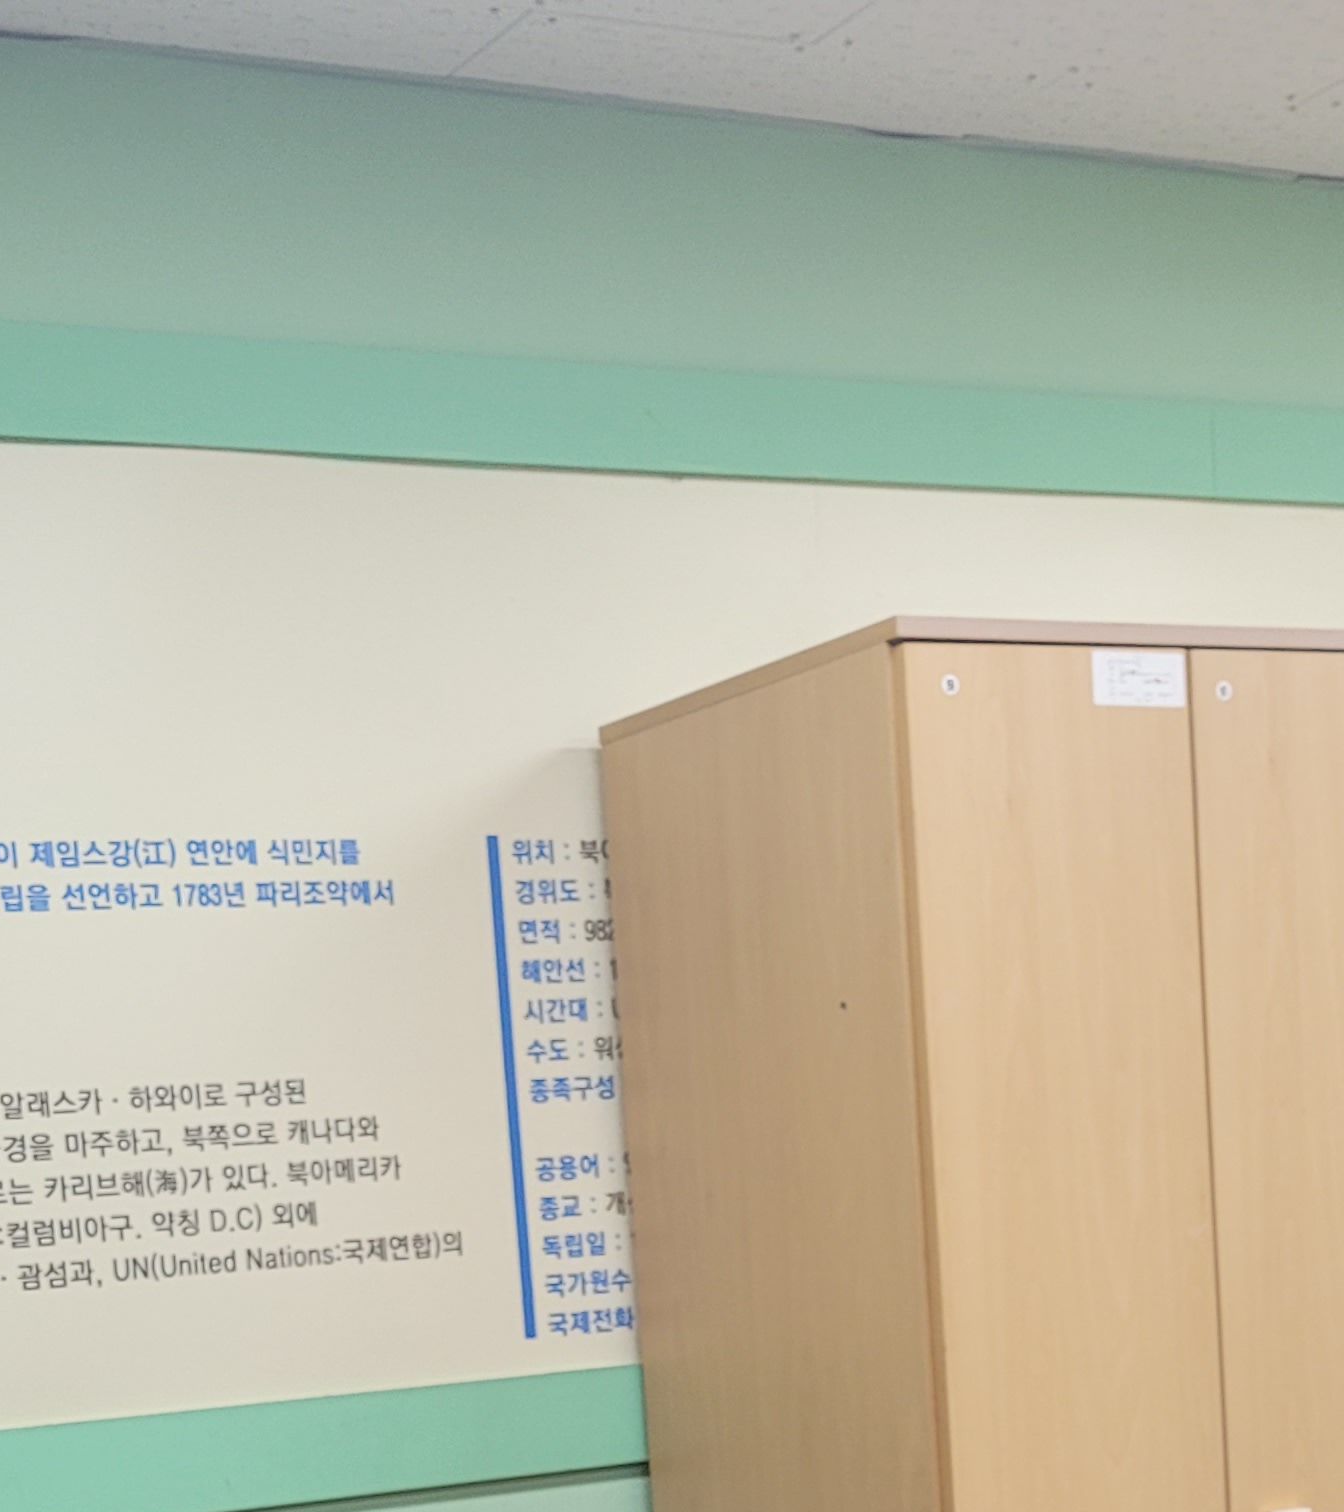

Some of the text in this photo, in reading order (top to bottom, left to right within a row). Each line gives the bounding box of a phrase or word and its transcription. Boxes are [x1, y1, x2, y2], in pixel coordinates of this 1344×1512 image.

[185, 839, 258, 867] 연안에
[266, 839, 361, 866] 식민지를
[511, 839, 555, 865] 위치
[61, 882, 164, 911] 선언하고
[172, 881, 246, 908] 1783년
[255, 879, 394, 907] 파리조약에서
[515, 879, 581, 906] 경위도
[517, 919, 561, 945] 면적
[521, 957, 586, 984] 해안선
[523, 997, 588, 1025] 시간대
[527, 1038, 570, 1064] 수도
[235, 1078, 306, 1107] 구성된
[529, 1075, 616, 1103] 종족구성
[64, 1128, 173, 1159] 마주하고,
[183, 1122, 279, 1152] 북쪽으로
[287, 1115, 380, 1145] 캐나다와
[222, 1162, 277, 1192] 있다.
[287, 1154, 401, 1187] 북아메리카
[535, 1153, 600, 1183] 공용어
[151, 1209, 200, 1238] 약칭
[209, 1203, 263, 1233] D.C)
[272, 1201, 318, 1229] 외에
[539, 1195, 583, 1222] 종교
[541, 1231, 606, 1260] 독립일
[112, 1249, 237, 1282] UN(United
[544, 1268, 633, 1298] 국가원수
[548, 1306, 634, 1336] 국제전화
